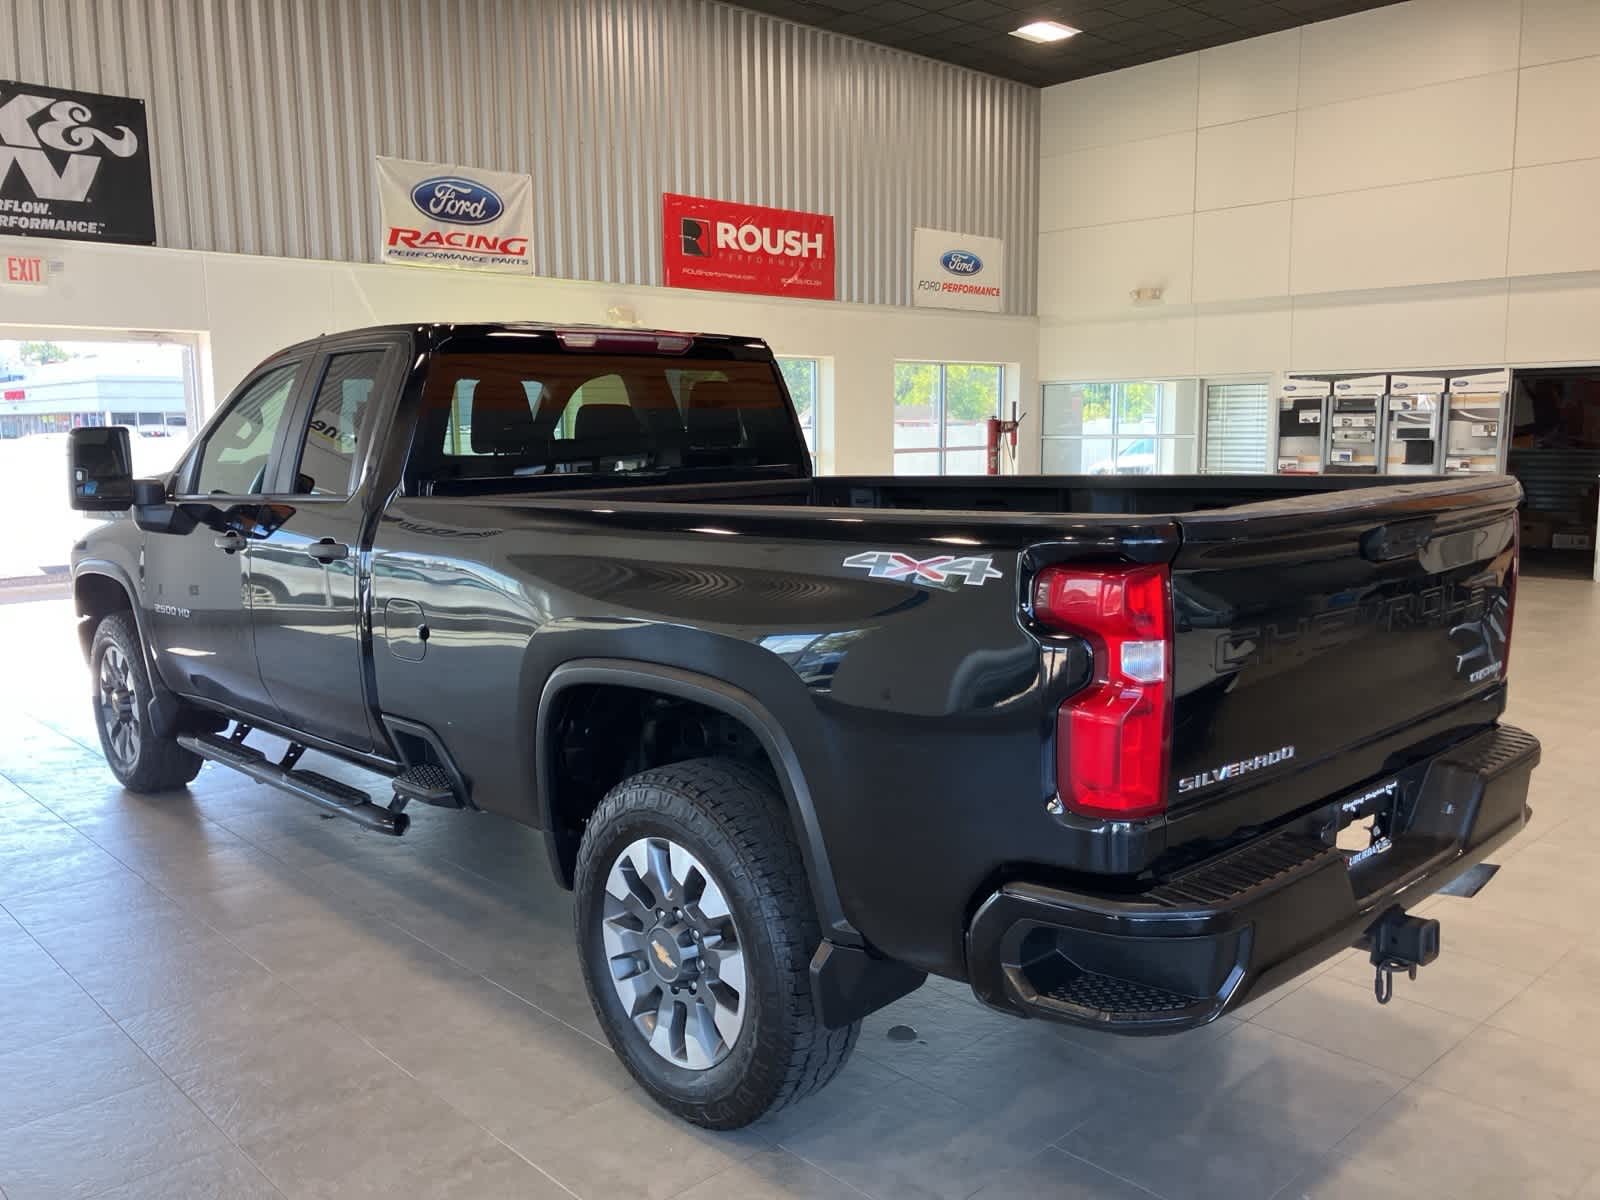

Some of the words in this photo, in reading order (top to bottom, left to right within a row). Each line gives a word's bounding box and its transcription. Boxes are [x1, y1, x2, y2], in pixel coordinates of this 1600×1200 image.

[429, 183, 486, 218] Ford
[388, 227, 529, 256] RACING
[716, 221, 823, 259] ROUSH
[8, 256, 41, 282] EXIT
[388, 249, 487, 263] PERFORMANCE
[491, 257, 529, 266] PARTS
[948, 253, 976, 272] Ford
[918, 280, 941, 291] FORD
[942, 282, 1000, 297] PERFORMANCE
[153, 603, 176, 616] 2500
[177, 607, 190, 618] HD
[1178, 745, 1295, 793] SILVERADO
